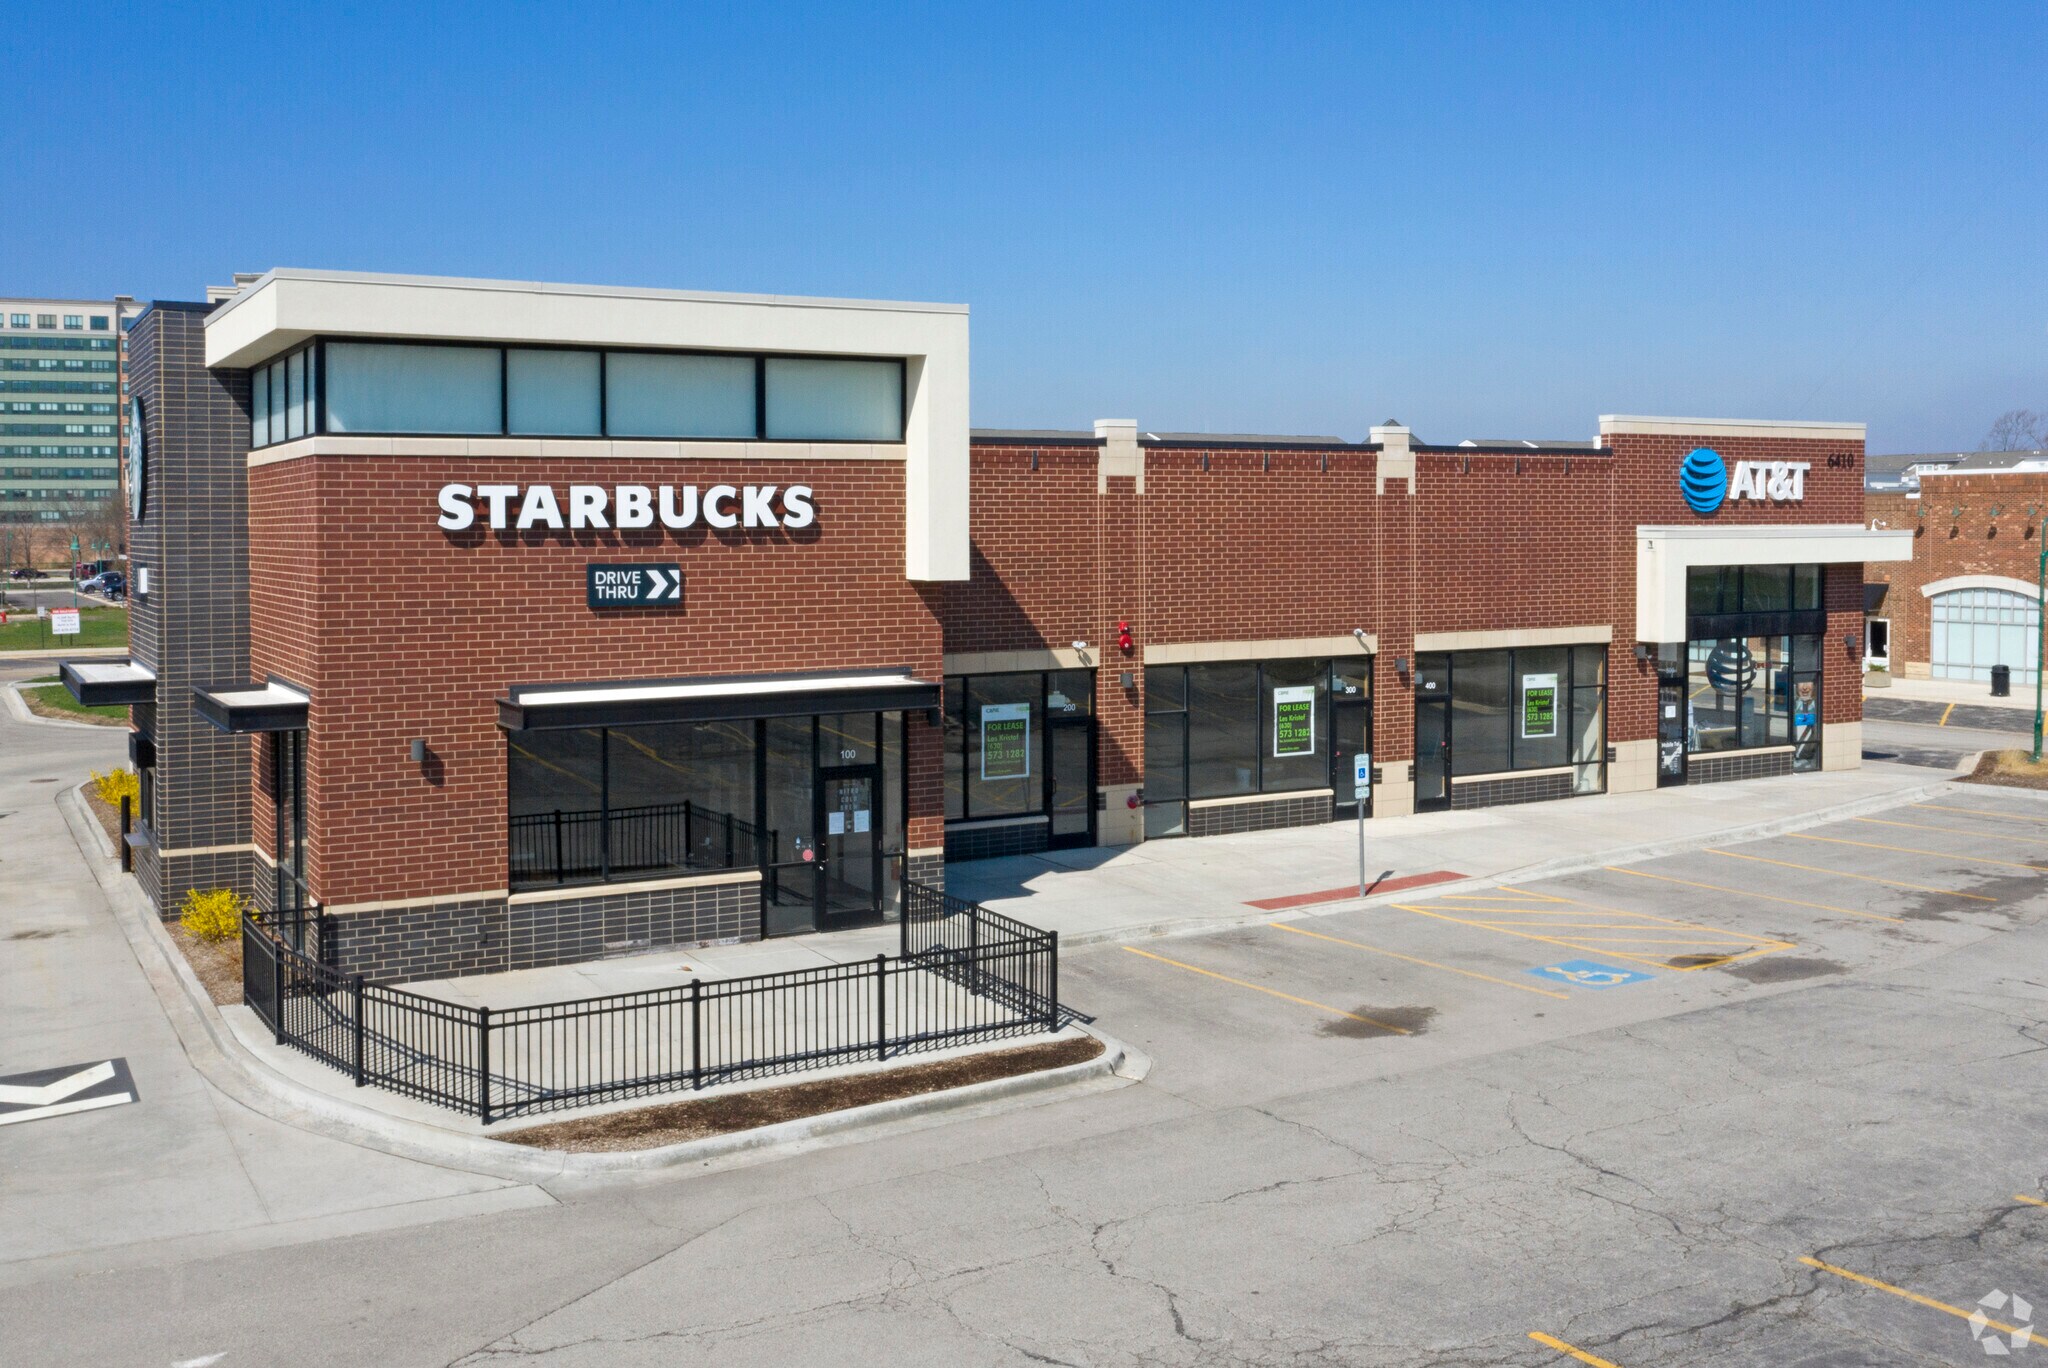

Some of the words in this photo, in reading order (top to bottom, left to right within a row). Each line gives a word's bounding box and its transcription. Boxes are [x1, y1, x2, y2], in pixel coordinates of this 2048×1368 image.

[1828, 454, 1854, 468] 6410
[1729, 461, 1810, 500] AT&T
[437, 484, 814, 530] STARBUCKS
[594, 570, 641, 585] DRIVE
[595, 586, 638, 599] THRU
[1280, 730, 1292, 738] 573
[1294, 729, 1310, 737] 1282
[841, 750, 856, 759] 100
[988, 750, 1003, 760] 573
[1006, 749, 1025, 758] 1282
